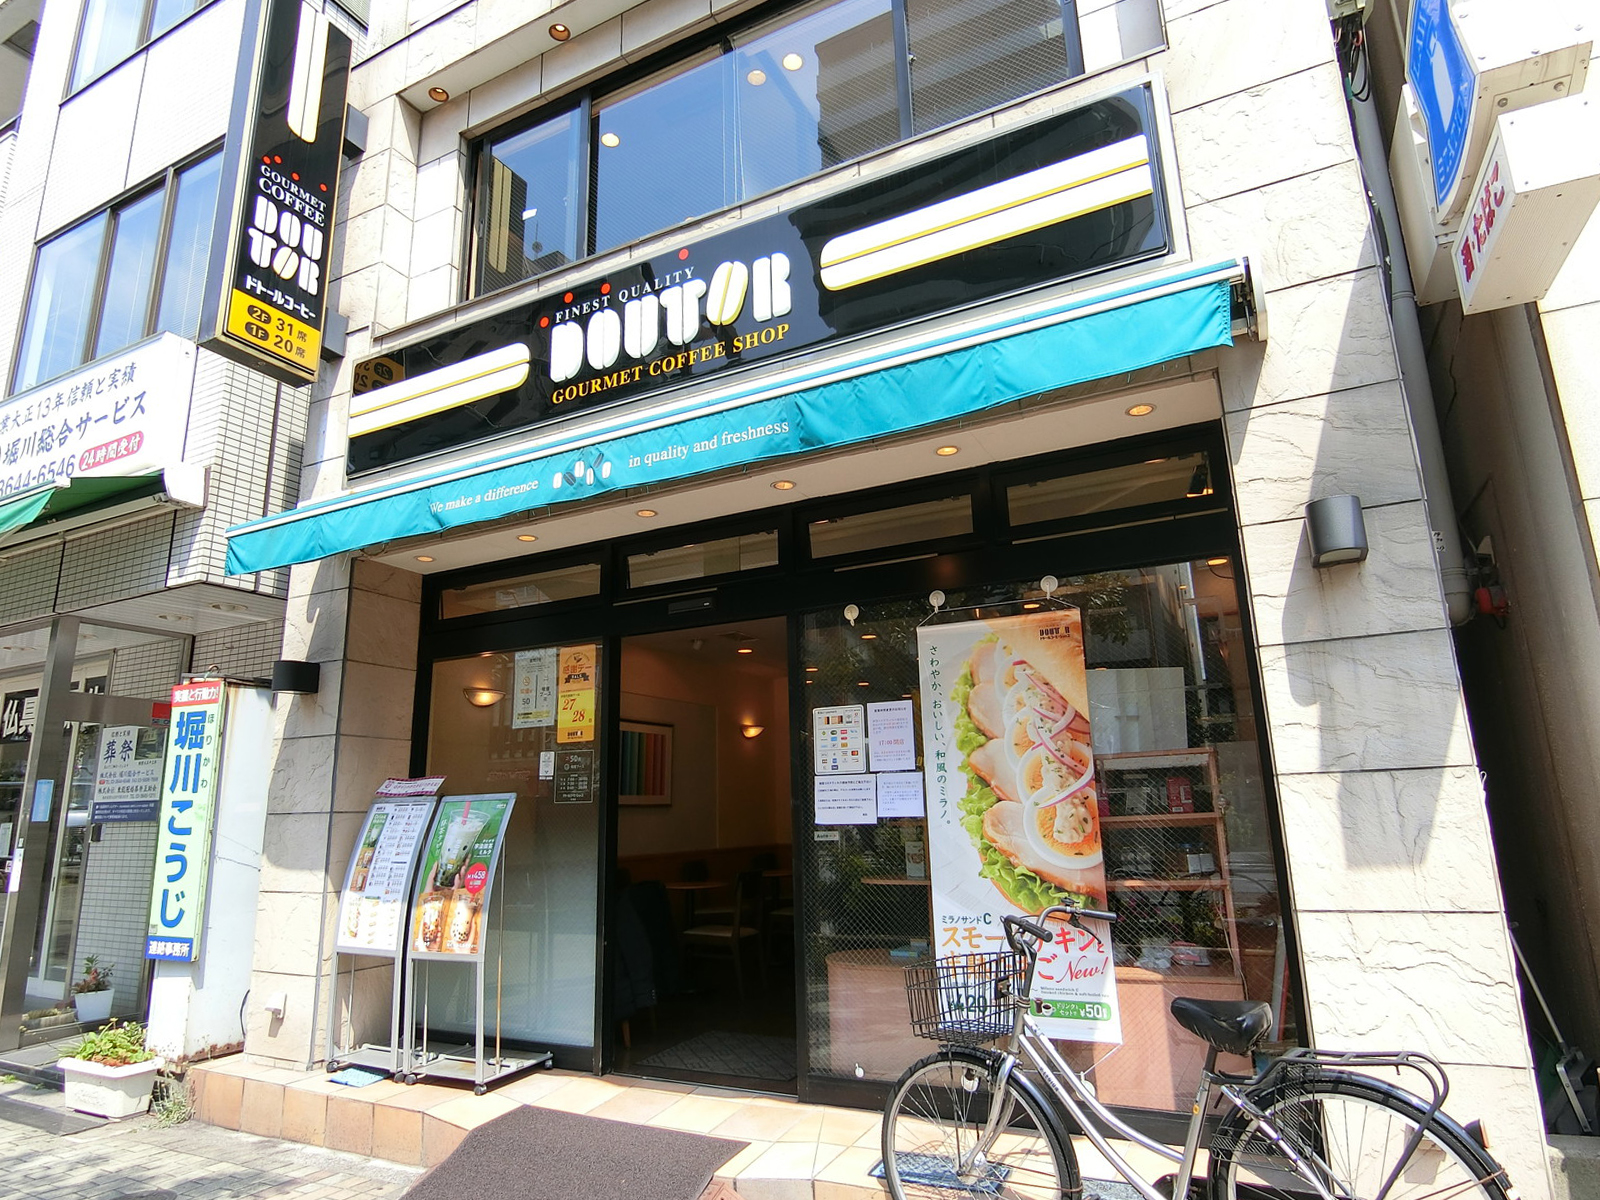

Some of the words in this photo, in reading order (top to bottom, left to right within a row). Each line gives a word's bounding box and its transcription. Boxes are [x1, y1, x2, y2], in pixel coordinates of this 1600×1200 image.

[258, 177, 325, 227] COFFEE
[260, 165, 327, 212] GOURMET
[245, 274, 316, 319] ドトールコーヒー
[550, 252, 792, 383] DOUTOR
[554, 295, 611, 324] FINEST
[618, 266, 695, 303] QUALITY
[551, 366, 643, 405] GOURMET
[649, 341, 727, 376] COFFEE
[732, 323, 790, 354] SHOP
[3, 391, 147, 466] 堀川総合サービス
[628, 455, 642, 468] in
[644, 444, 690, 467] quality
[693, 435, 718, 454] and
[721, 420, 790, 446] freshness
[430, 501, 444, 515] We
[445, 496, 474, 511] make
[475, 494, 482, 504] a
[484, 480, 540, 502] difference
[562, 698, 576, 710] 27
[571, 709, 586, 722] 28
[200, 713, 215, 789] ほりかわ
[929, 645, 951, 825] さわやか、おいしい、和風のミラノ。
[160, 710, 207, 929] 堀川こうじ
[1055, 955, 1109, 983] New!
